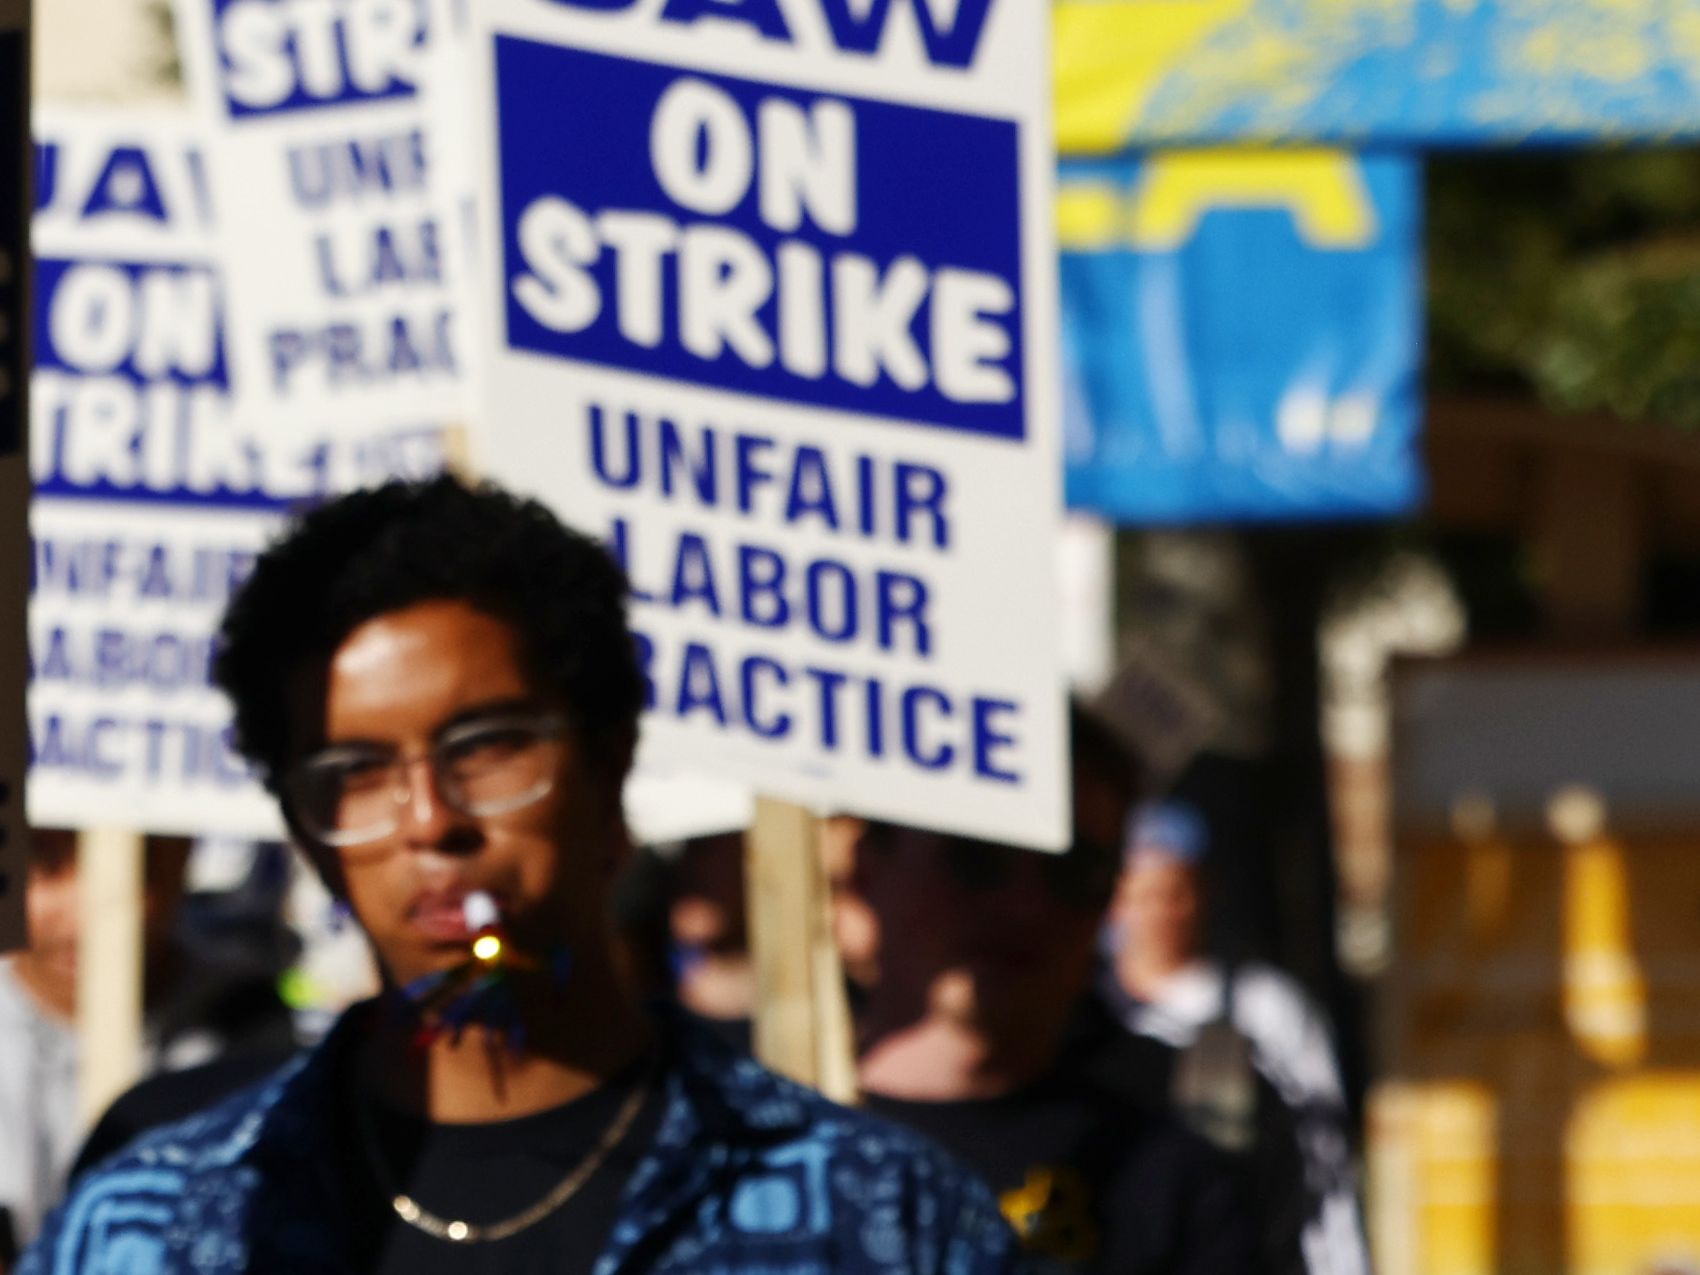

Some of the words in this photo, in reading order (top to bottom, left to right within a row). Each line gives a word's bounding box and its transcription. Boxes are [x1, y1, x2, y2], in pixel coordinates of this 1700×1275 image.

[648, 77, 856, 236] ON
[49, 260, 222, 378] ON
[512, 195, 1016, 403] STRIKE
[586, 403, 952, 549] UNFAIR
[611, 519, 935, 657] LABOR
[628, 629, 1024, 785] ACTICE
